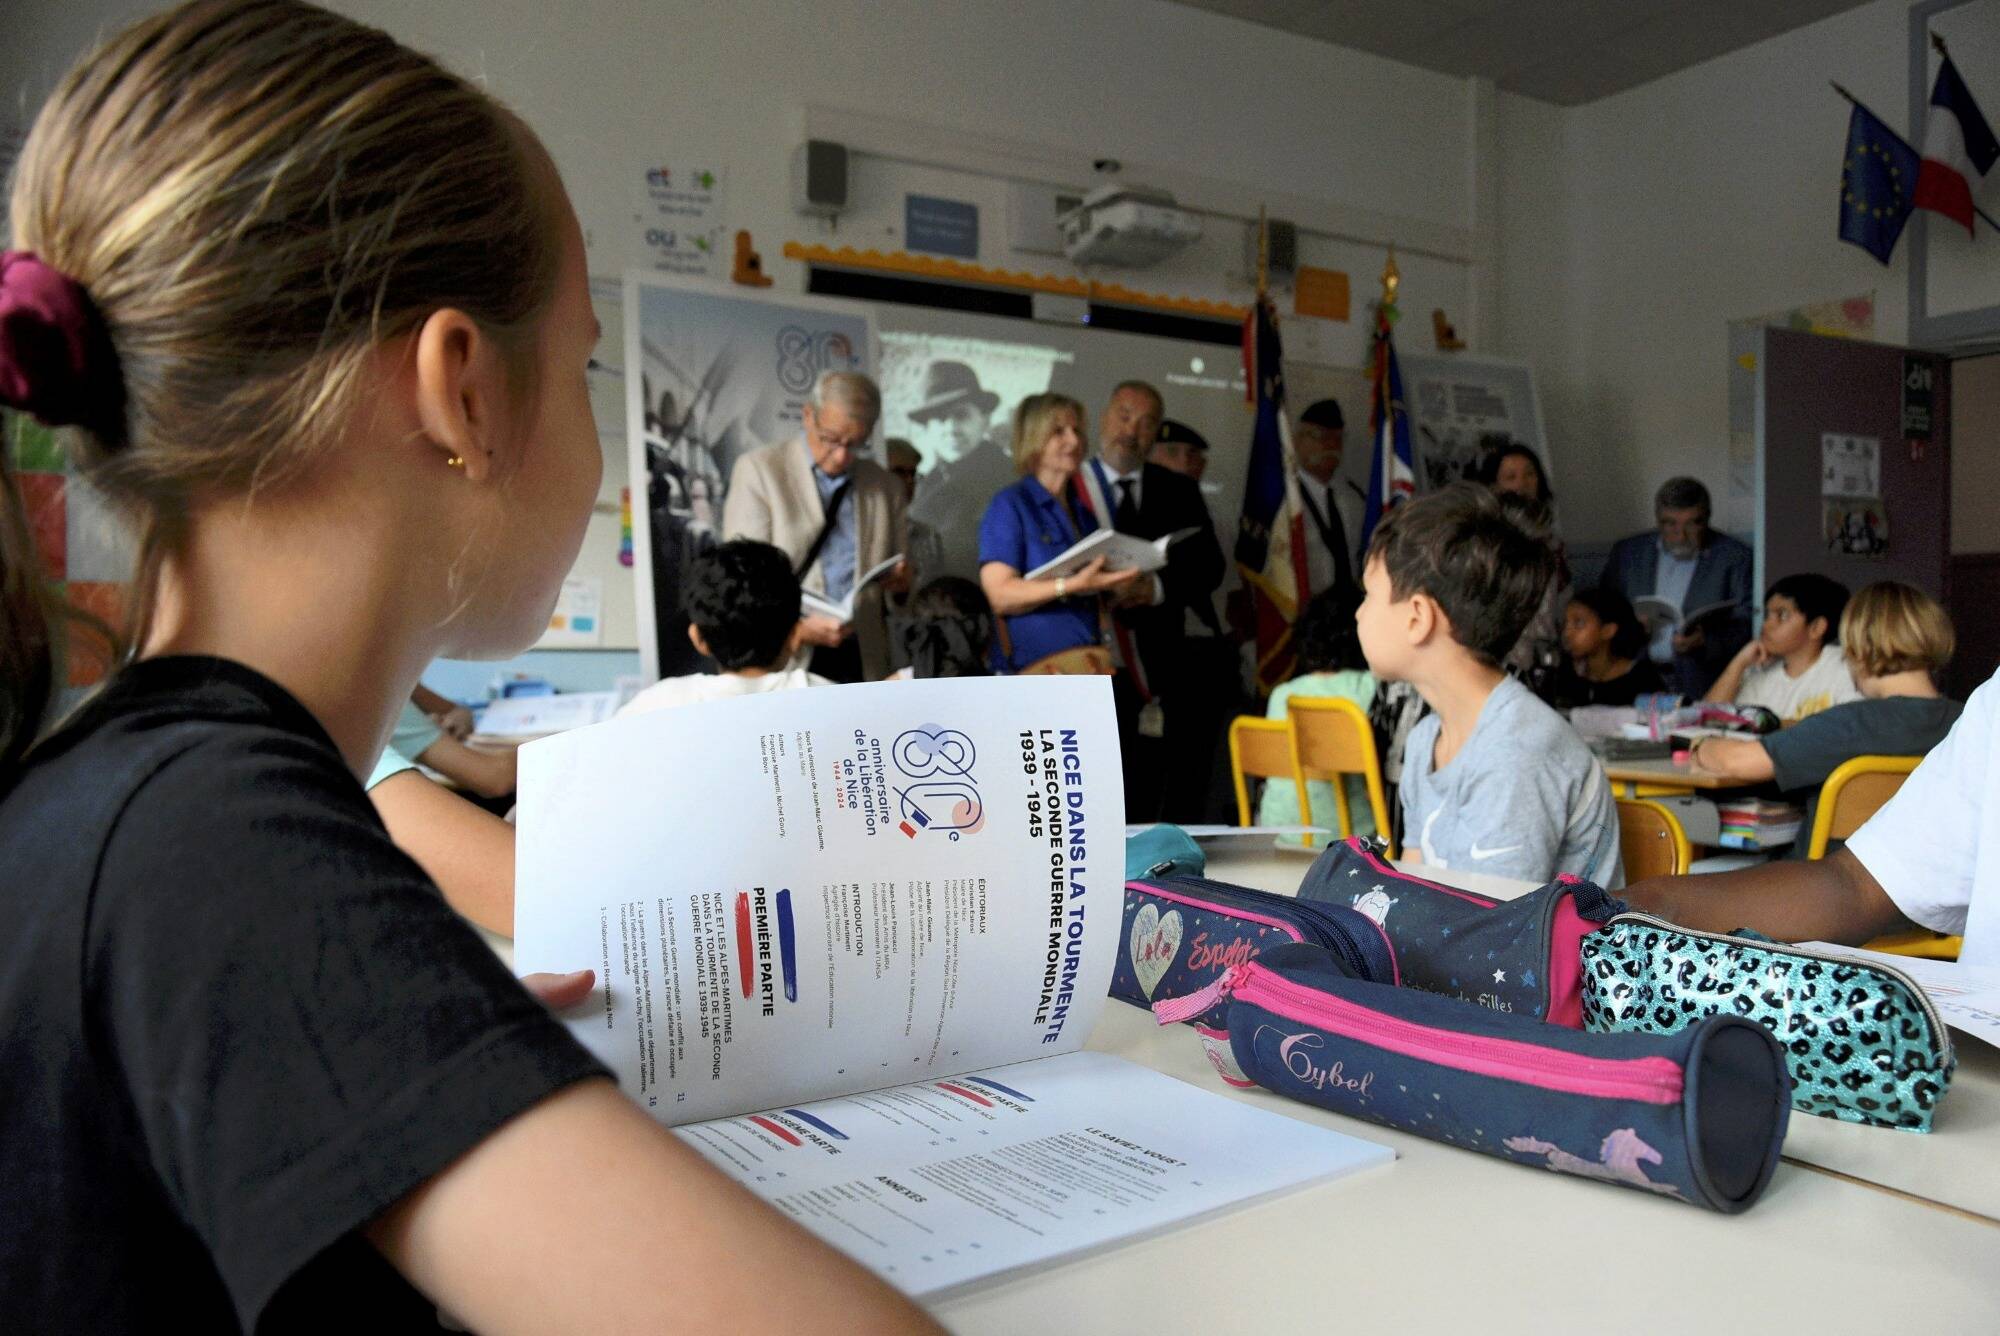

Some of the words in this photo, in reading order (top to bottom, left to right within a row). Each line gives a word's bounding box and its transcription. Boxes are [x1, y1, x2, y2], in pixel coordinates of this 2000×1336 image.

[855, 729, 866, 746] de
[858, 750, 868, 761] la
[1020, 731, 1036, 774] 1939
[1040, 730, 1054, 752] LA
[844, 759, 854, 776] de
[1060, 729, 1081, 785] NICE
[811, 781, 818, 790] de
[846, 780, 858, 809] Nice
[871, 738, 892, 824] anniversaire
[860, 766, 876, 836] Libération
[1026, 794, 1042, 838] 1945
[1043, 758, 1062, 848] SECONDE
[1066, 792, 1085, 861] DANS
[1050, 853, 1062, 927] GUERRE
[1070, 868, 1085, 898] LA
[690, 895, 701, 933] GUERRE
[702, 894, 711, 919] DANS
[713, 893, 722, 914] NICE
[852, 883, 864, 956] INTRODUCTION
[704, 922, 712, 934] LA
[715, 917, 723, 928] ET
[717, 931, 726, 950] LES
[754, 888, 772, 960] PREMIÈRE
[632, 952, 639, 961] du
[667, 906, 673, 915] La
[676, 1011, 681, 1021] un
[694, 936, 705, 987] MONDIALE
[1136, 930, 1172, 965] Lola
[638, 909, 645, 918] La
[647, 1029, 653, 1039] un
[706, 937, 717, 997] TOURMENTE
[1034, 932, 1061, 1025] MONDIALE
[1042, 906, 1085, 1045] TOURMENTE
[635, 986, 642, 995] de
[710, 1000, 718, 1014] DE
[719, 953, 731, 1044] ALPES-MARITIMES
[760, 963, 774, 1016] PARTIE
[698, 991, 709, 1039] 1939-1945
[711, 1017, 719, 1030] LA
[712, 1033, 720, 1080] SECONDE
[1254, 1024, 1374, 1100] Cybel
[678, 1092, 685, 1102] 11
[994, 1096, 1029, 1113] PARTIE
[806, 1134, 842, 1155] PARTIE
[1100, 1132, 1178, 1164] SAVIEZ-VOUS
[875, 1176, 928, 1203] ANNEXES
